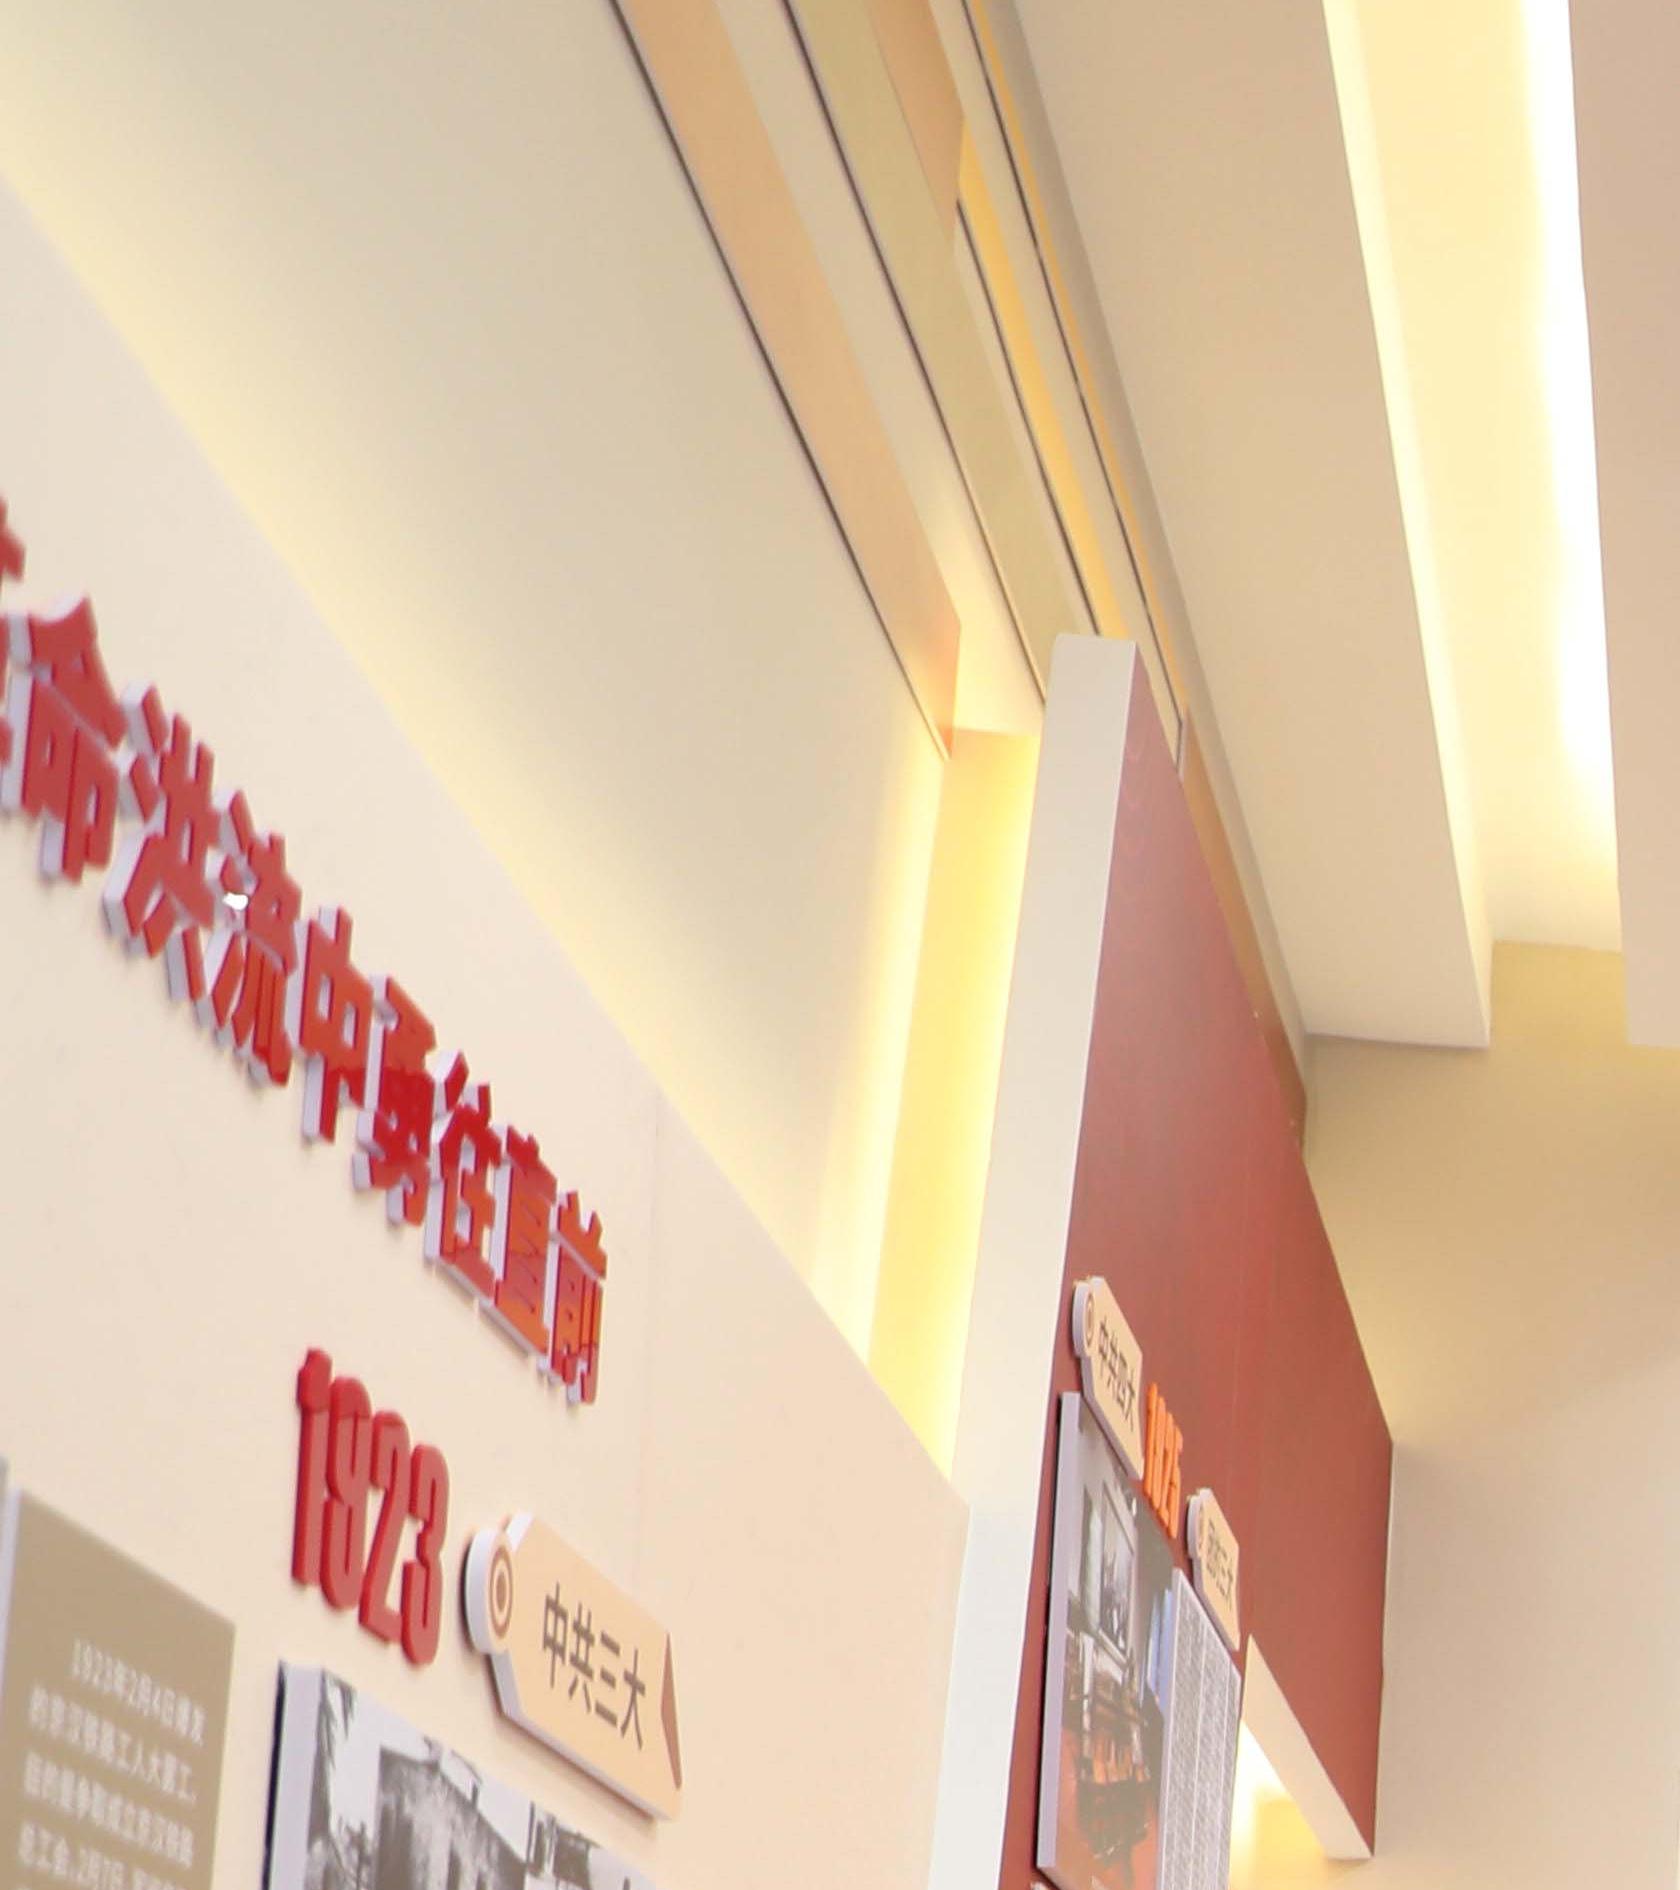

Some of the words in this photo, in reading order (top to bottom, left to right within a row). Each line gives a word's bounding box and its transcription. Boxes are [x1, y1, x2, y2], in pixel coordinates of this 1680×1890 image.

[292, 1348, 450, 1666] 1923
[541, 1581, 647, 1750] 中共三大
